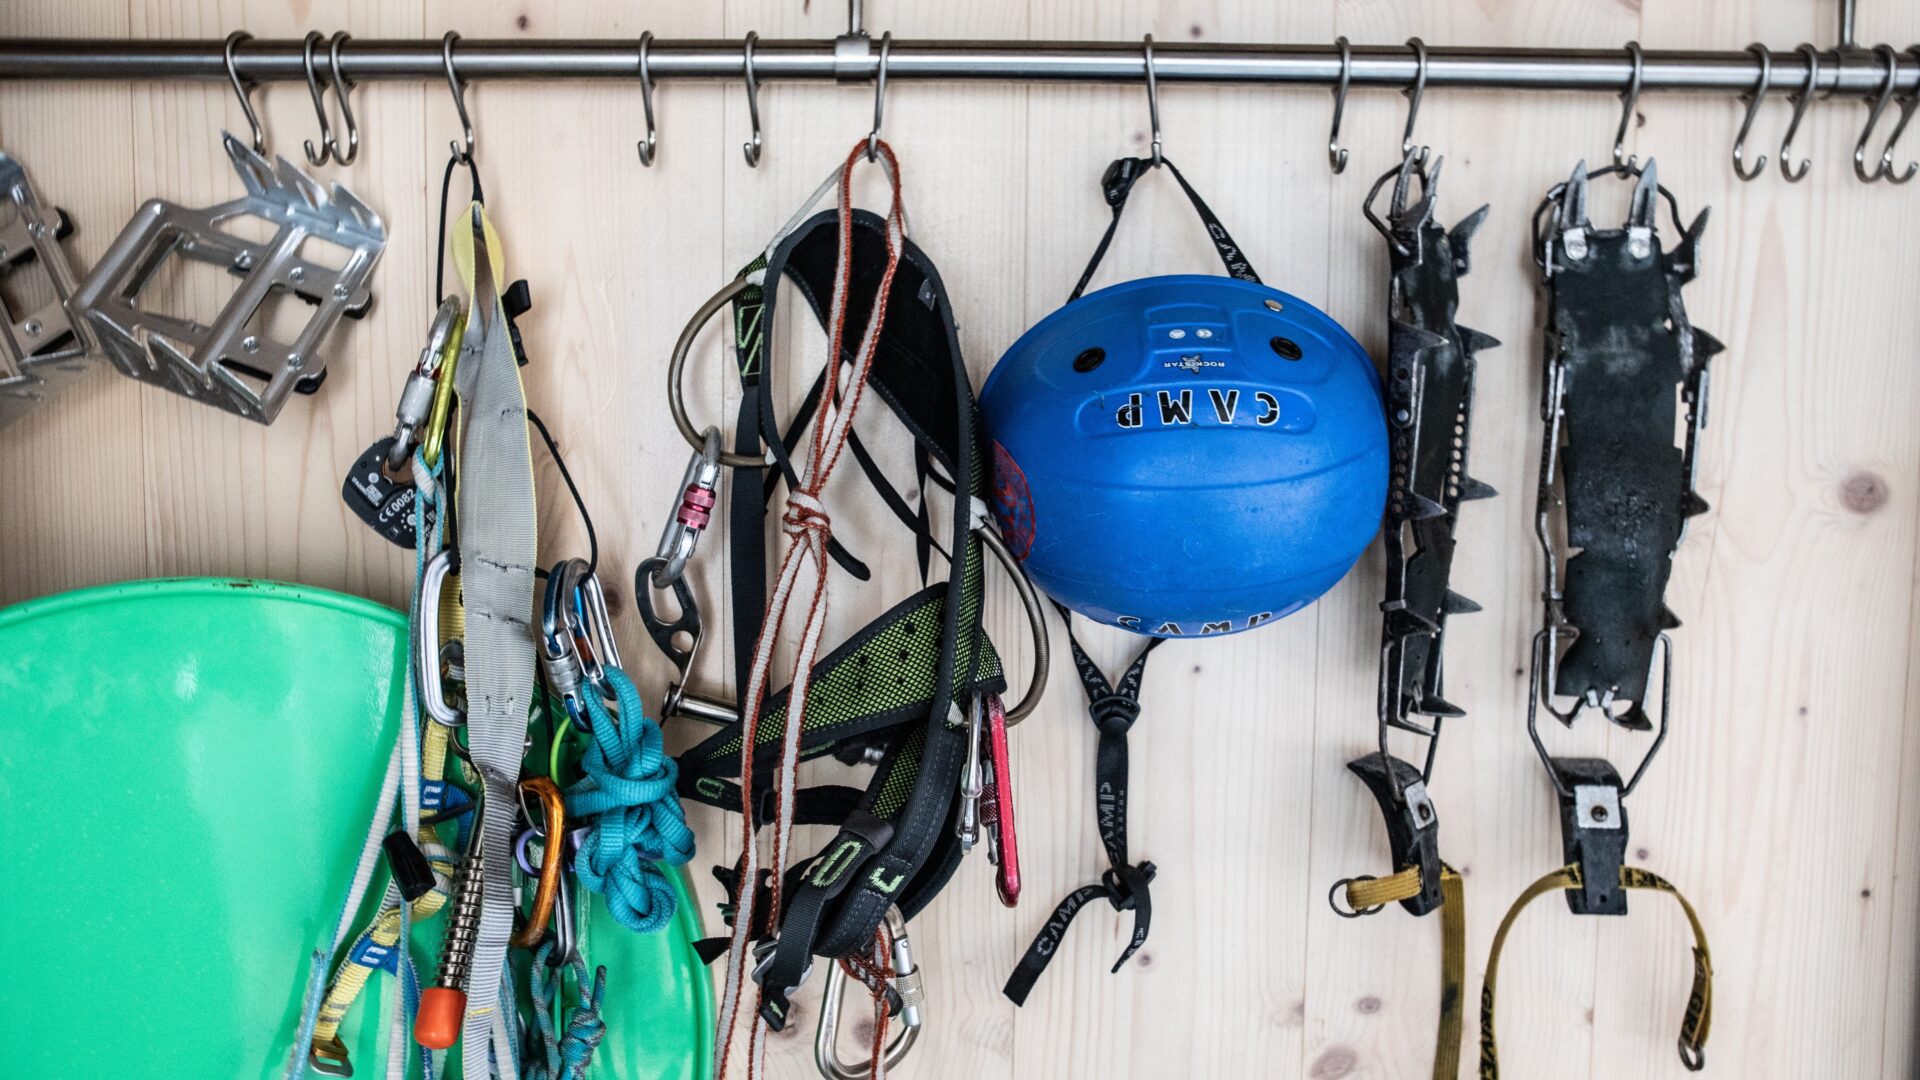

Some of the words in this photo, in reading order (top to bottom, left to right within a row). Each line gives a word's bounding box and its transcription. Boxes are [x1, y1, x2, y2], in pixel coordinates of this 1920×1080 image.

[1115, 389, 1281, 428] CAMP
[1116, 611, 1272, 635] CAMP
[1037, 887, 1094, 957] CAMP
